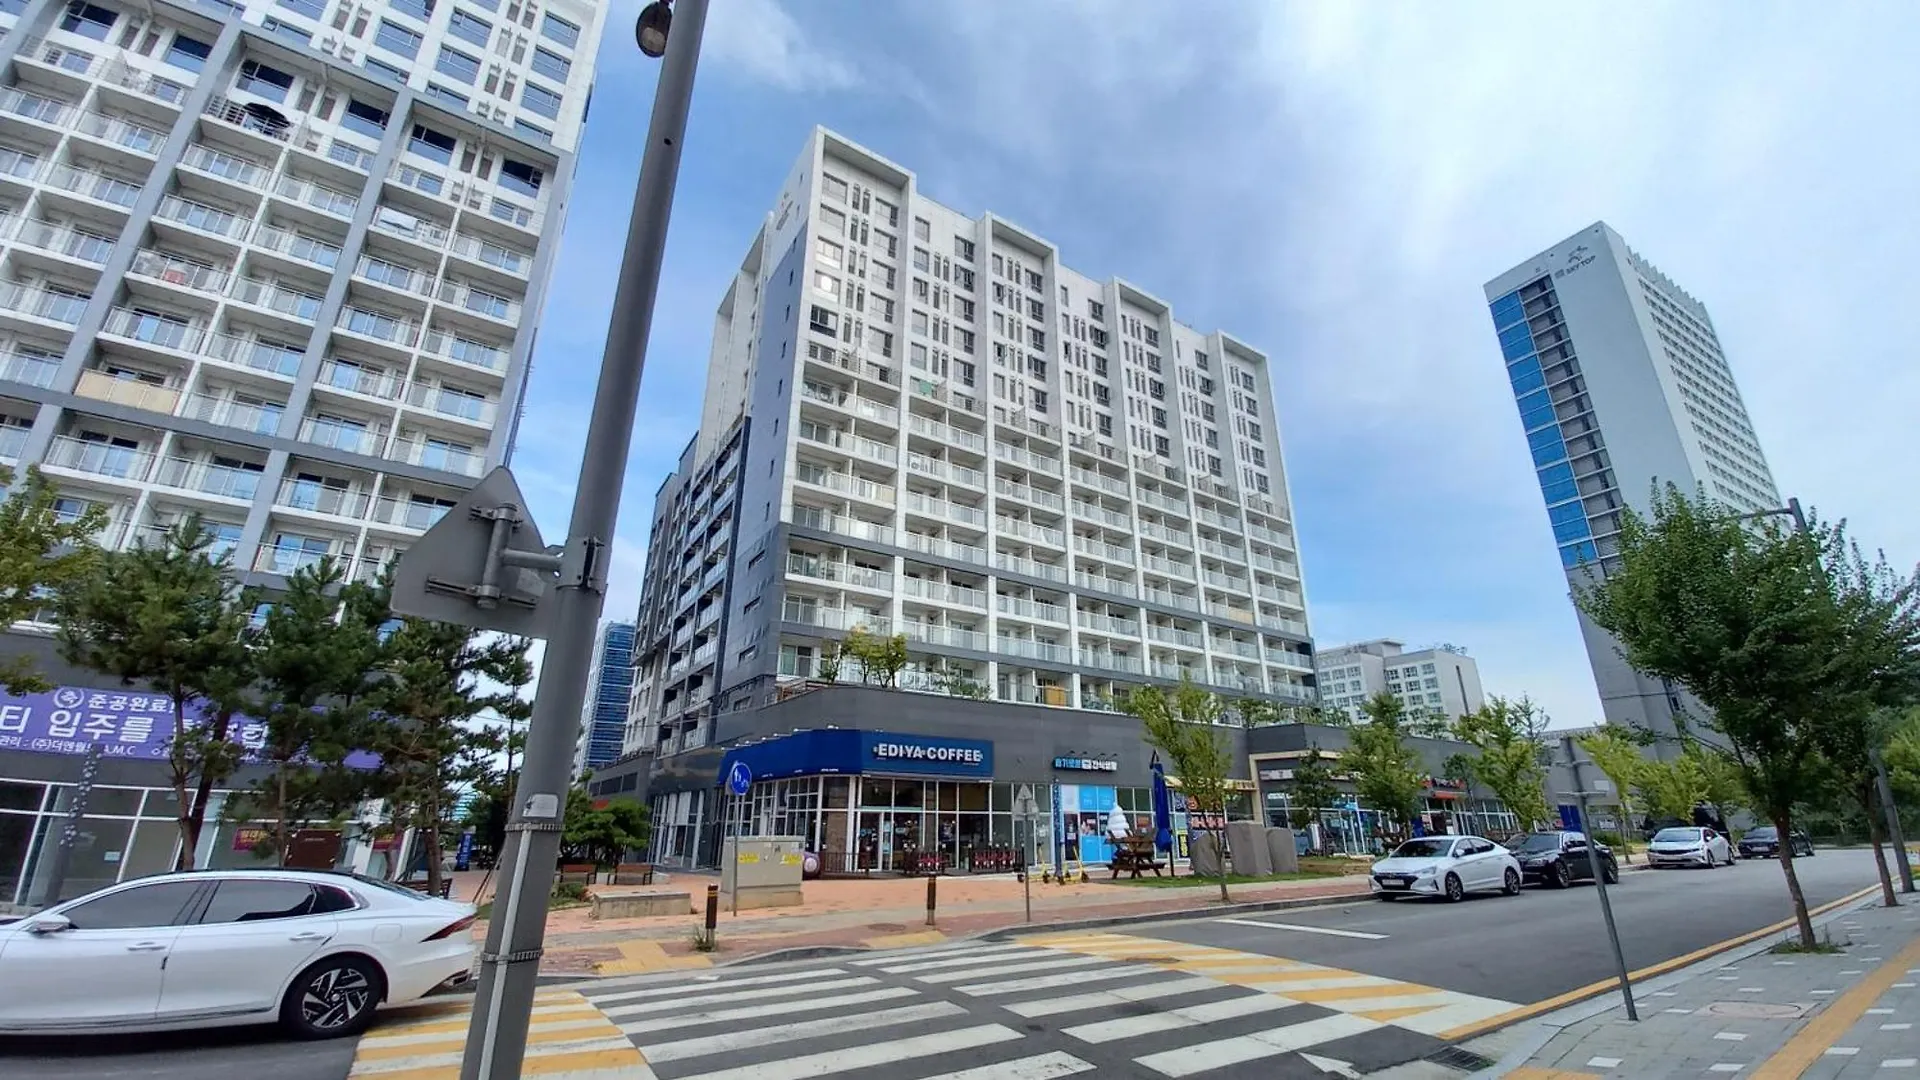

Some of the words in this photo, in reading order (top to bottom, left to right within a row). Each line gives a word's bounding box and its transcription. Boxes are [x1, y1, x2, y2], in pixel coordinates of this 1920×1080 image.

[48, 709, 154, 743] 입주를
[877, 743, 923, 759] EDIYA
[926, 747, 982, 762] COFFEE
